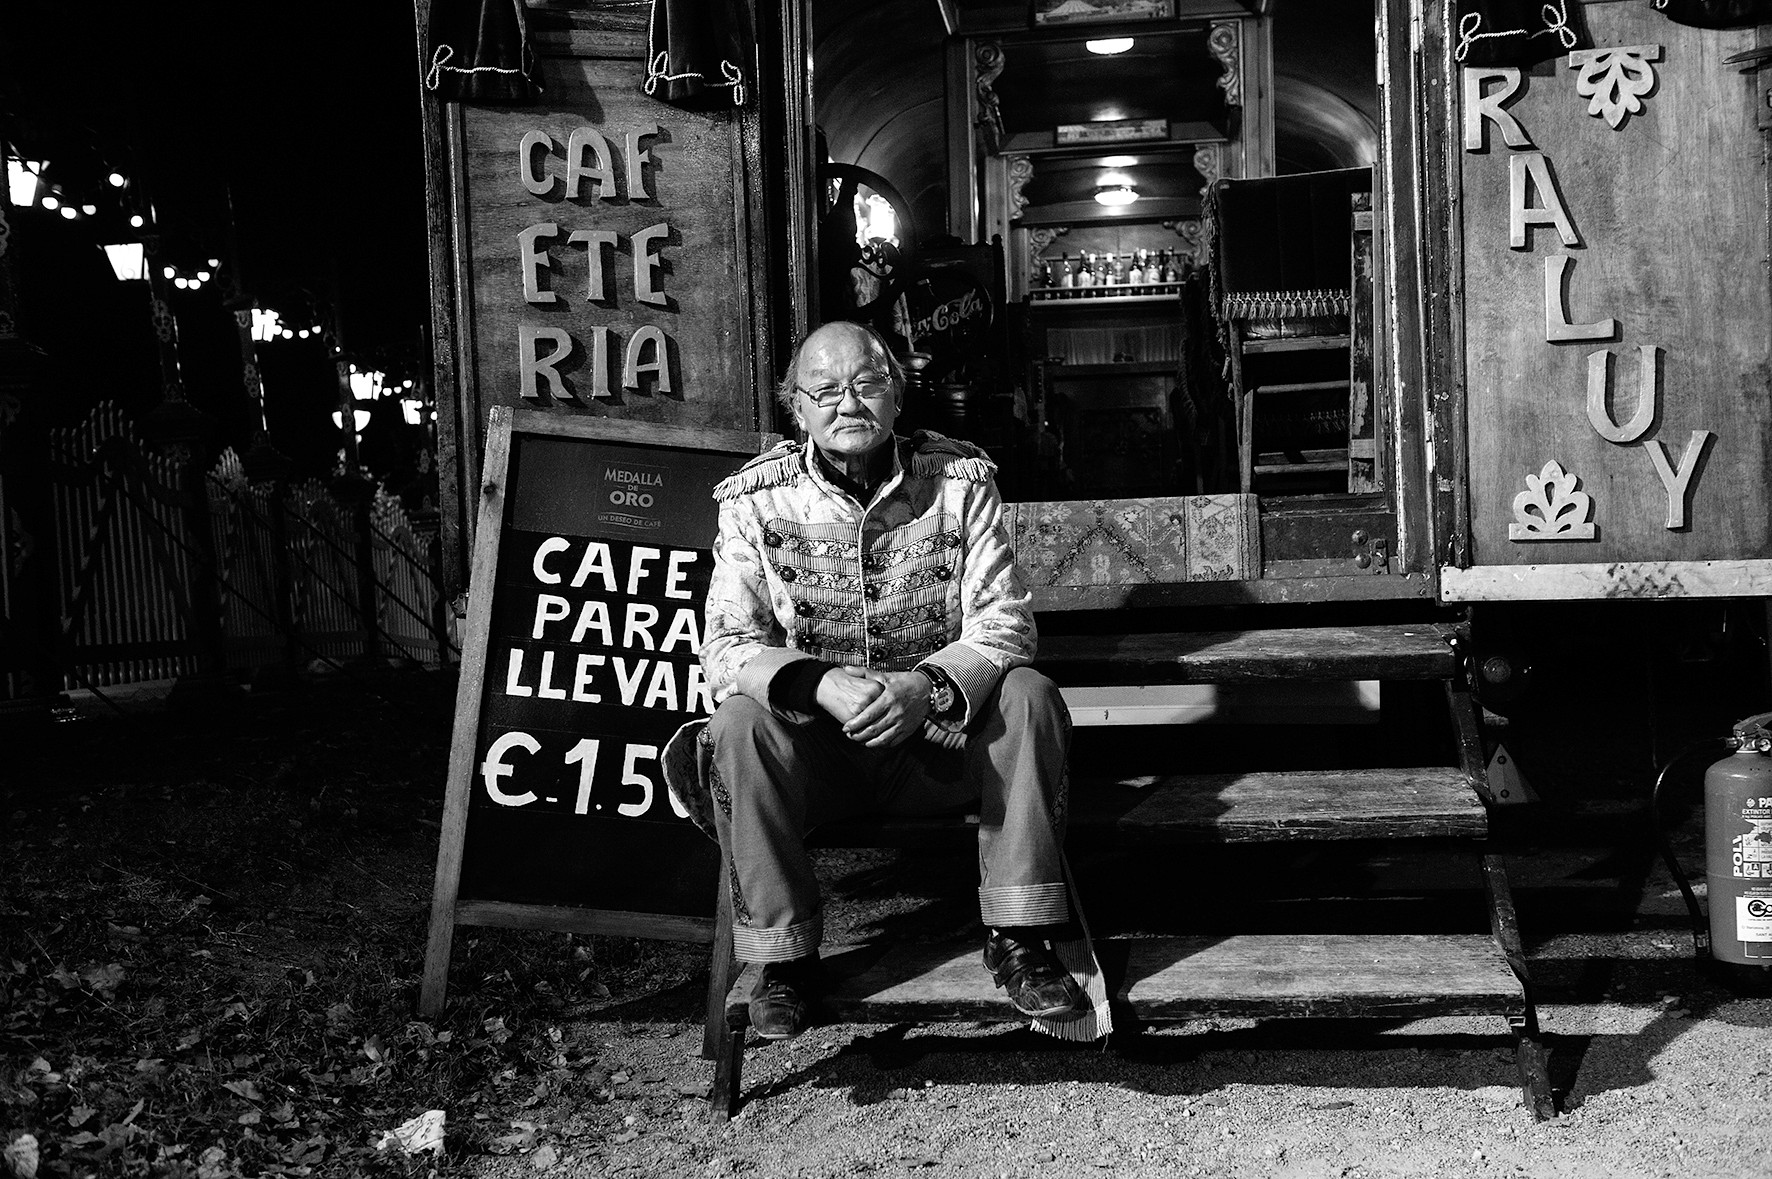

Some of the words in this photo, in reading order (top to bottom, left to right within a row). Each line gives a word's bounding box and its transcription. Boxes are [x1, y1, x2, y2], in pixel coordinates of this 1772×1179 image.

[519, 122, 659, 200] CAF
[518, 223, 669, 306] ETE
[1464, 66, 1710, 529] RALUY
[518, 325, 672, 400] RIA
[604, 467, 663, 487] MEDALLA
[609, 490, 654, 508] ORO
[610, 515, 632, 524] DESEO
[532, 536, 698, 600] CAFE
[532, 593, 701, 655] PARA
[504, 648, 716, 716] LLEVAR
